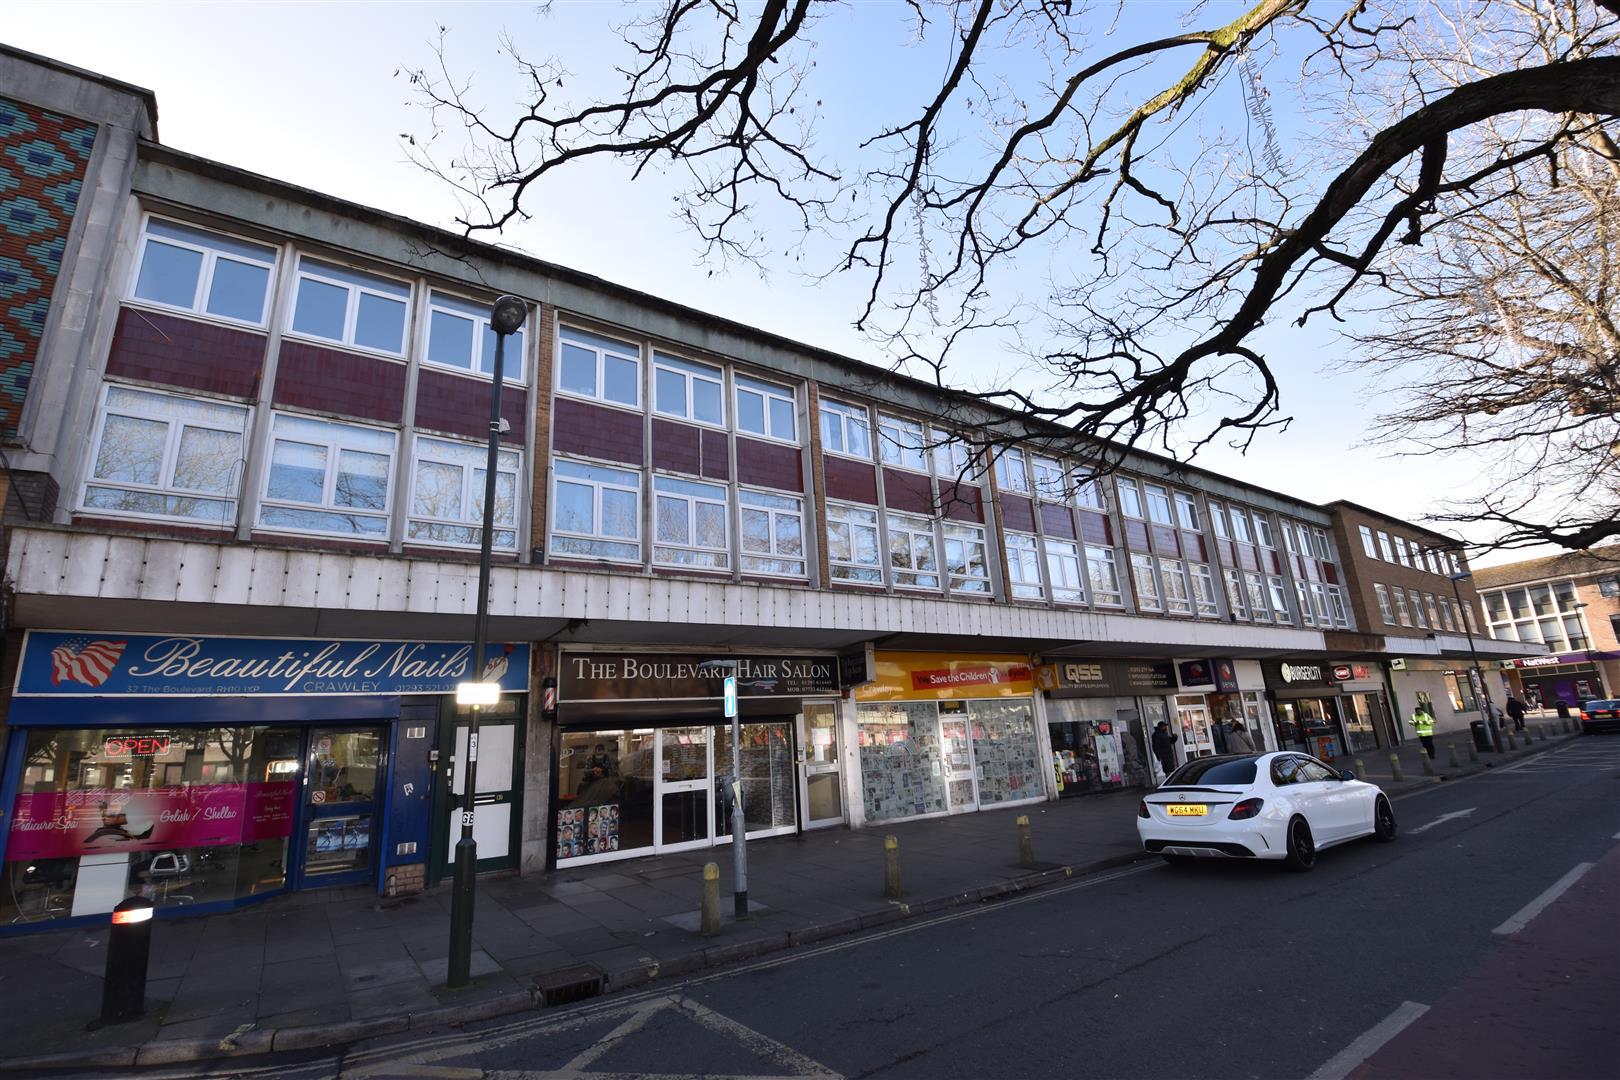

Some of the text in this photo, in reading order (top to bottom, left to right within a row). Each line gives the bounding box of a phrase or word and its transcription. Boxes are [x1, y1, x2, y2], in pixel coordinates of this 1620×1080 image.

[128, 638, 473, 691] Beautiful Nails
[573, 658, 617, 680] THE
[737, 659, 778, 679] HAIR
[781, 659, 831, 679] SALON
[1522, 656, 1560, 667] NatWest
[930, 674, 948, 684] Save
[948, 673, 959, 682] the
[959, 671, 988, 682] Children
[1065, 664, 1103, 683] QSS
[1289, 665, 1322, 681] BURGERCITY
[142, 685, 158, 693] The
[303, 681, 381, 693] CRAWLEY
[394, 684, 423, 692] 01293
[107, 738, 169, 755] OPEN
[160, 808, 190, 825] Gelish
[204, 806, 237, 821] Shellac
[11, 816, 79, 834] Pedicure Spa
